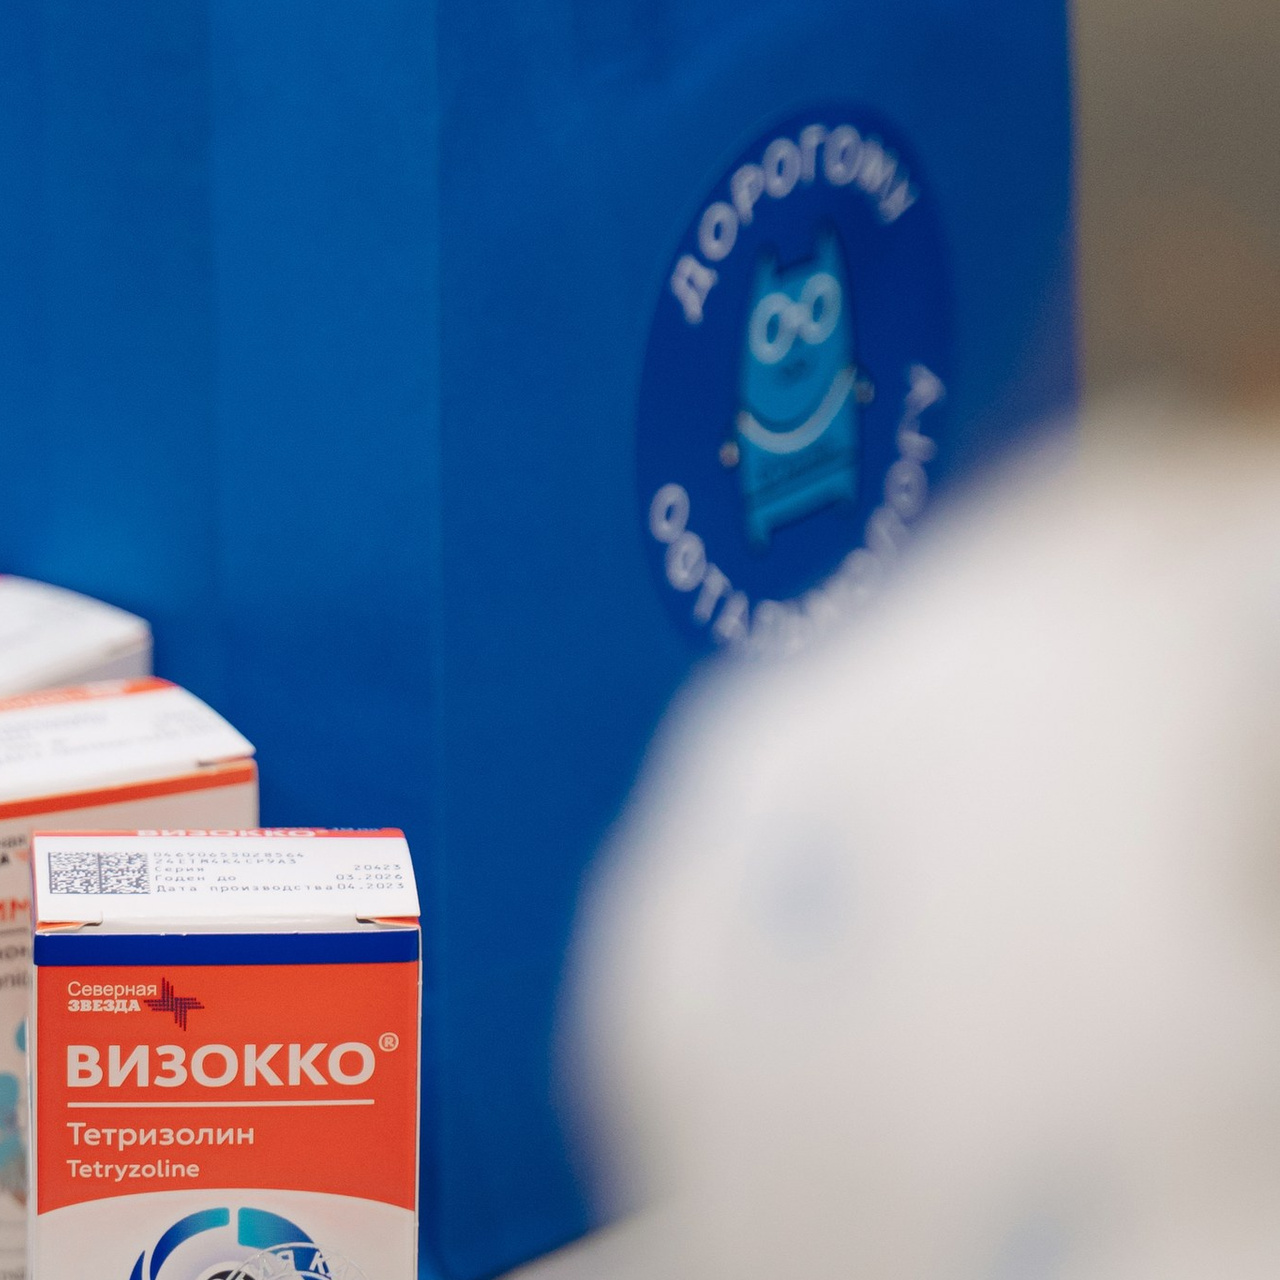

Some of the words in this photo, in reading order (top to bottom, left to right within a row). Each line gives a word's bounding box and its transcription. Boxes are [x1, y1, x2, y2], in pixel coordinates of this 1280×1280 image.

[671, 124, 916, 324] ДОРОГОМУ
[154, 874, 206, 882] Годен
[157, 884, 198, 893] Дата
[210, 884, 333, 893] производства
[67, 980, 157, 999] Северная
[67, 999, 142, 1014] ЗВЕЗДА
[67, 1122, 255, 1152] Тетризолин
[67, 1159, 200, 1182] Tetryzoline
